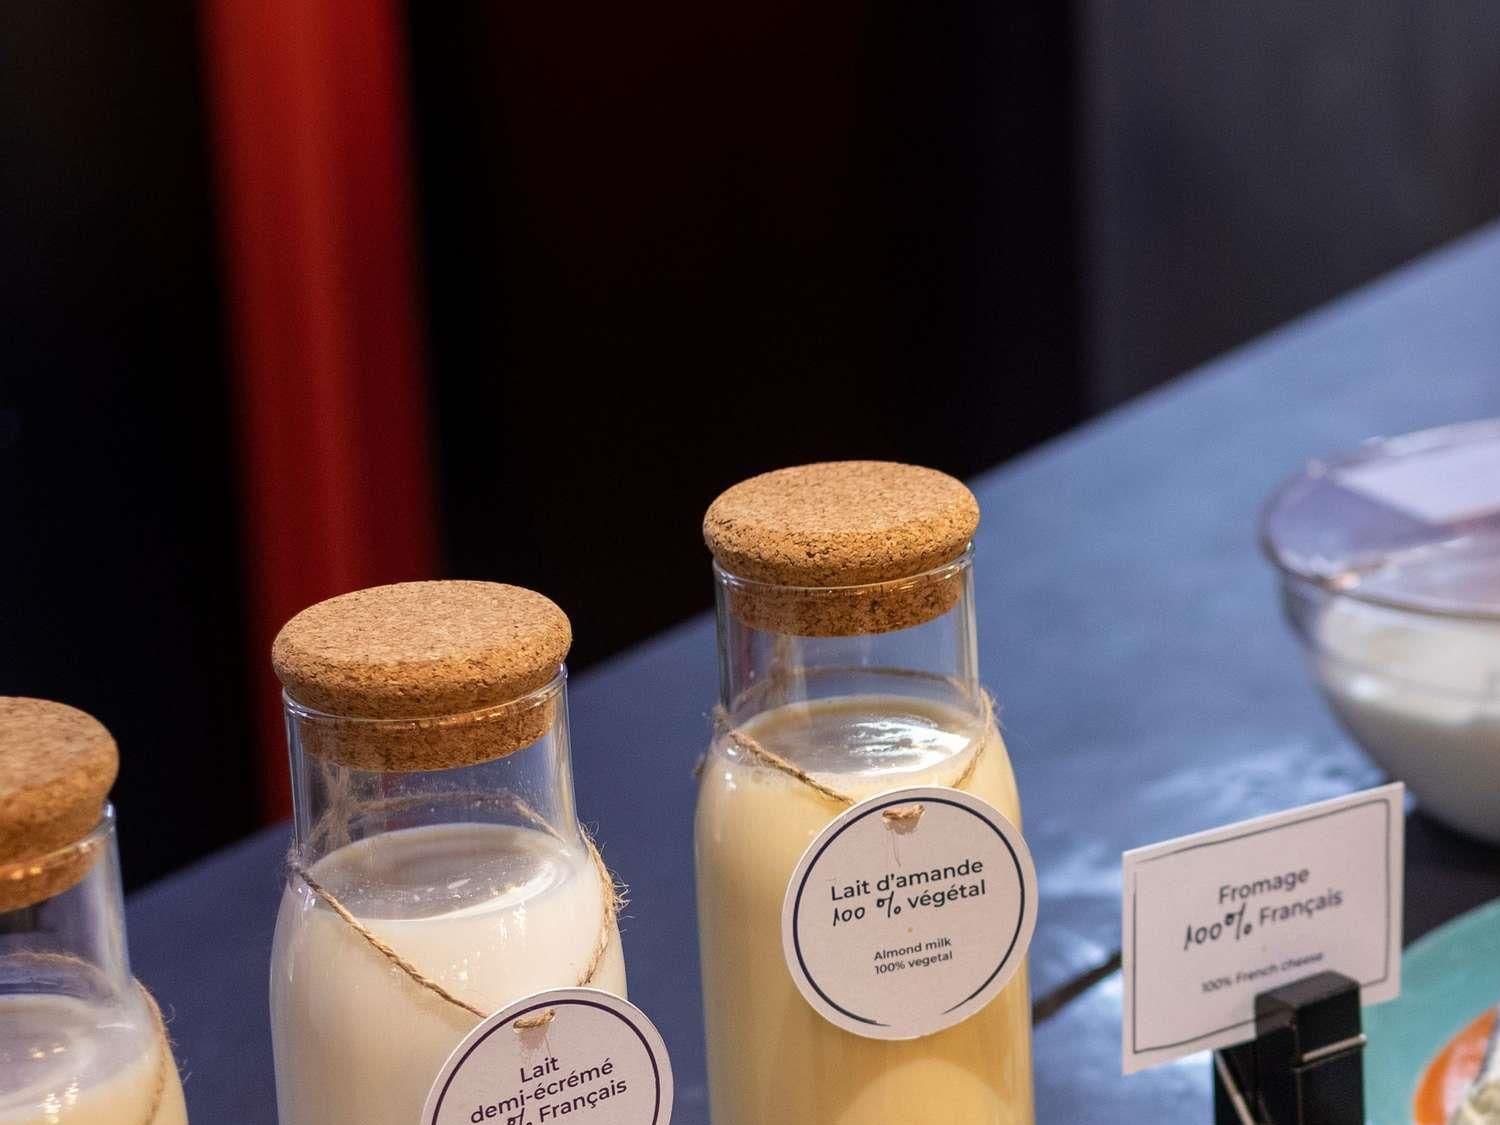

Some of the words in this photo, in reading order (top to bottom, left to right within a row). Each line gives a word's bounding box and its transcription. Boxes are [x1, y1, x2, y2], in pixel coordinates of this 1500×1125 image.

[831, 880, 870, 901] Lait
[877, 859, 984, 891] d'amande
[907, 880, 986, 910] végétal
[1219, 868, 1309, 904] Fromage
[1259, 889, 1343, 927] Français
[874, 943, 922, 961] Almond
[925, 938, 952, 951] milk
[875, 961, 905, 974] 100%
[907, 952, 953, 969] vegetal
[1202, 976, 1232, 993] 100%
[1236, 964, 1278, 984] French
[1281, 952, 1323, 972] cheese
[520, 1057, 560, 1083] Lait
[470, 1058, 614, 1124] demi-écrémé
[539, 1080, 627, 1123] Français
